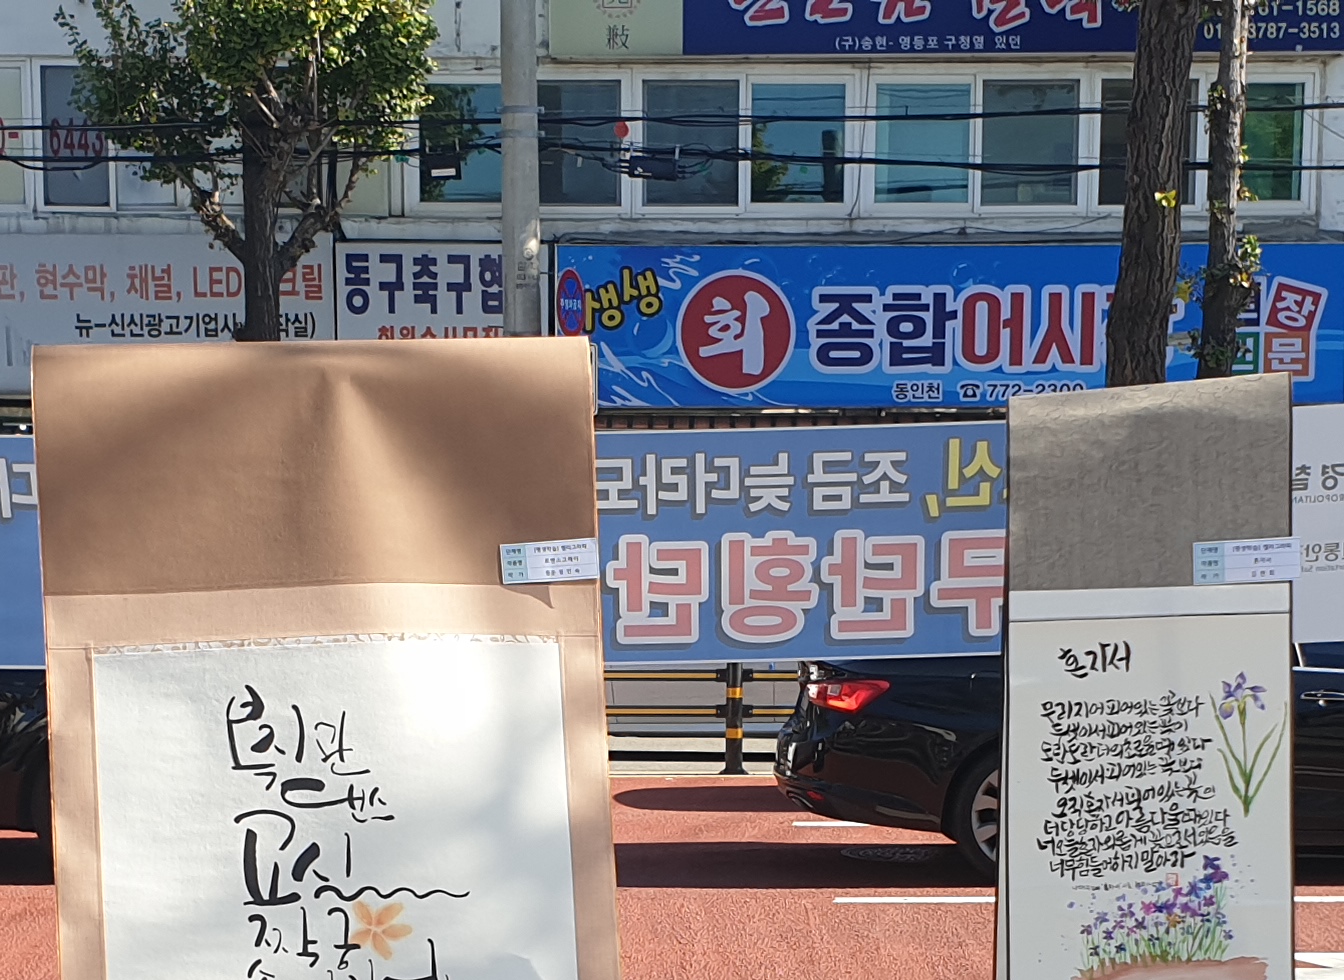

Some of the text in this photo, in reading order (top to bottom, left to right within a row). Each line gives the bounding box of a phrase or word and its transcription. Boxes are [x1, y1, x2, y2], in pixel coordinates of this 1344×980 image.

[899, 36, 939, 50] 영등포
[943, 35, 985, 51] 구청옆
[994, 35, 1022, 50] 있던
[1203, 22, 1340, 39] 013787-3513
[280, 263, 323, 300] 크릴
[699, 290, 775, 380] 회
[813, 288, 1114, 369] 종합어시
[893, 381, 941, 402] 동인천
